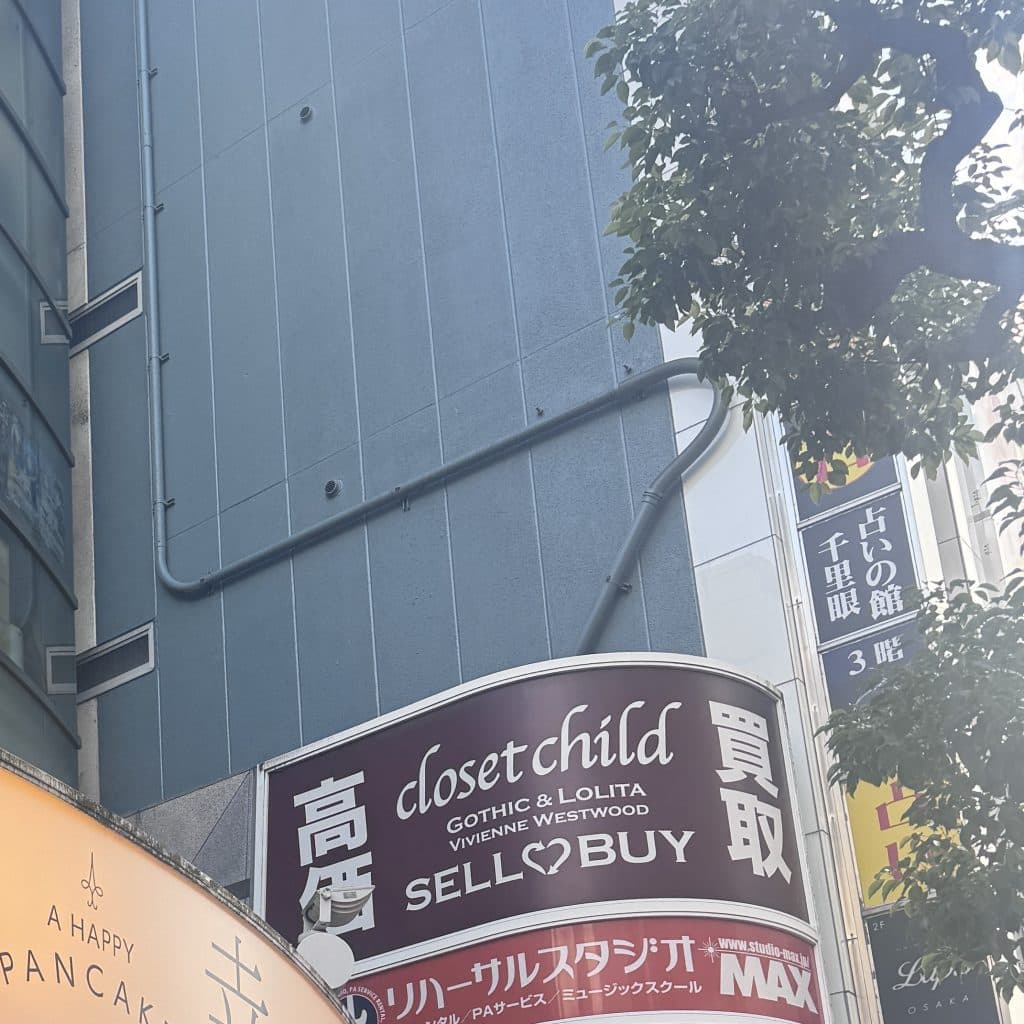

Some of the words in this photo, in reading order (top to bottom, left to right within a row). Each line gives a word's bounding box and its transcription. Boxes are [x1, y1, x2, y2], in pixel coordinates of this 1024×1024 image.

[818, 532, 861, 622] 千里眼
[858, 506, 904, 620] 占いの館
[446, 794, 530, 834] GOTHIC
[537, 793, 553, 807] &
[558, 782, 647, 804] LOLITA
[449, 820, 529, 852] VIVIENNE
[532, 803, 649, 827] WESTWOOD
[709, 700, 792, 885] 買取
[405, 852, 525, 912] SELL
[579, 830, 695, 868] BUY
[47, 904, 62, 932] A
[70, 917, 135, 965] HAPPY
[387, 934, 697, 1021] リハーサルスタジオ
[720, 953, 818, 1014] MAX
[908, 995, 969, 1014] OSAKA
